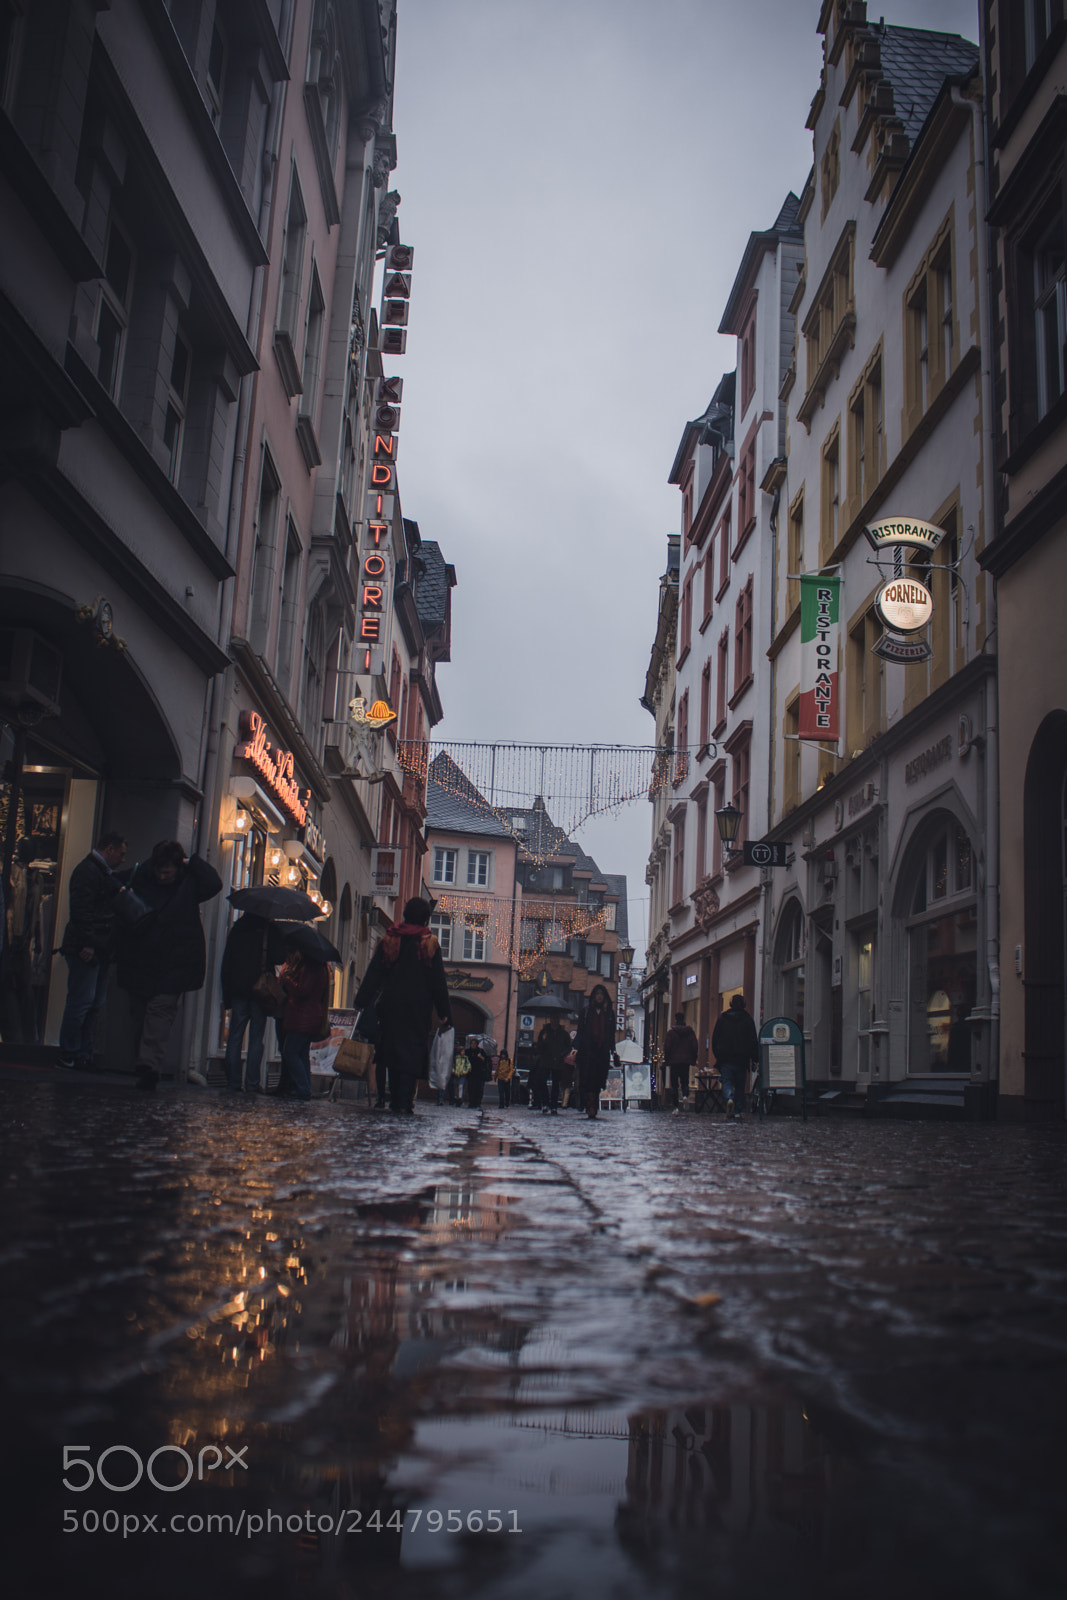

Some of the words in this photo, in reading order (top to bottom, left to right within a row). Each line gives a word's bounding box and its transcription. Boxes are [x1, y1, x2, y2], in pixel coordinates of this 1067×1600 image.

[361, 376, 401, 671] KONDITOREI
[872, 523, 941, 544] RISTORANTE
[885, 584, 927, 605] FORNELLI
[816, 589, 832, 727] RISTORANTE
[886, 643, 925, 656] PIZZERIA
